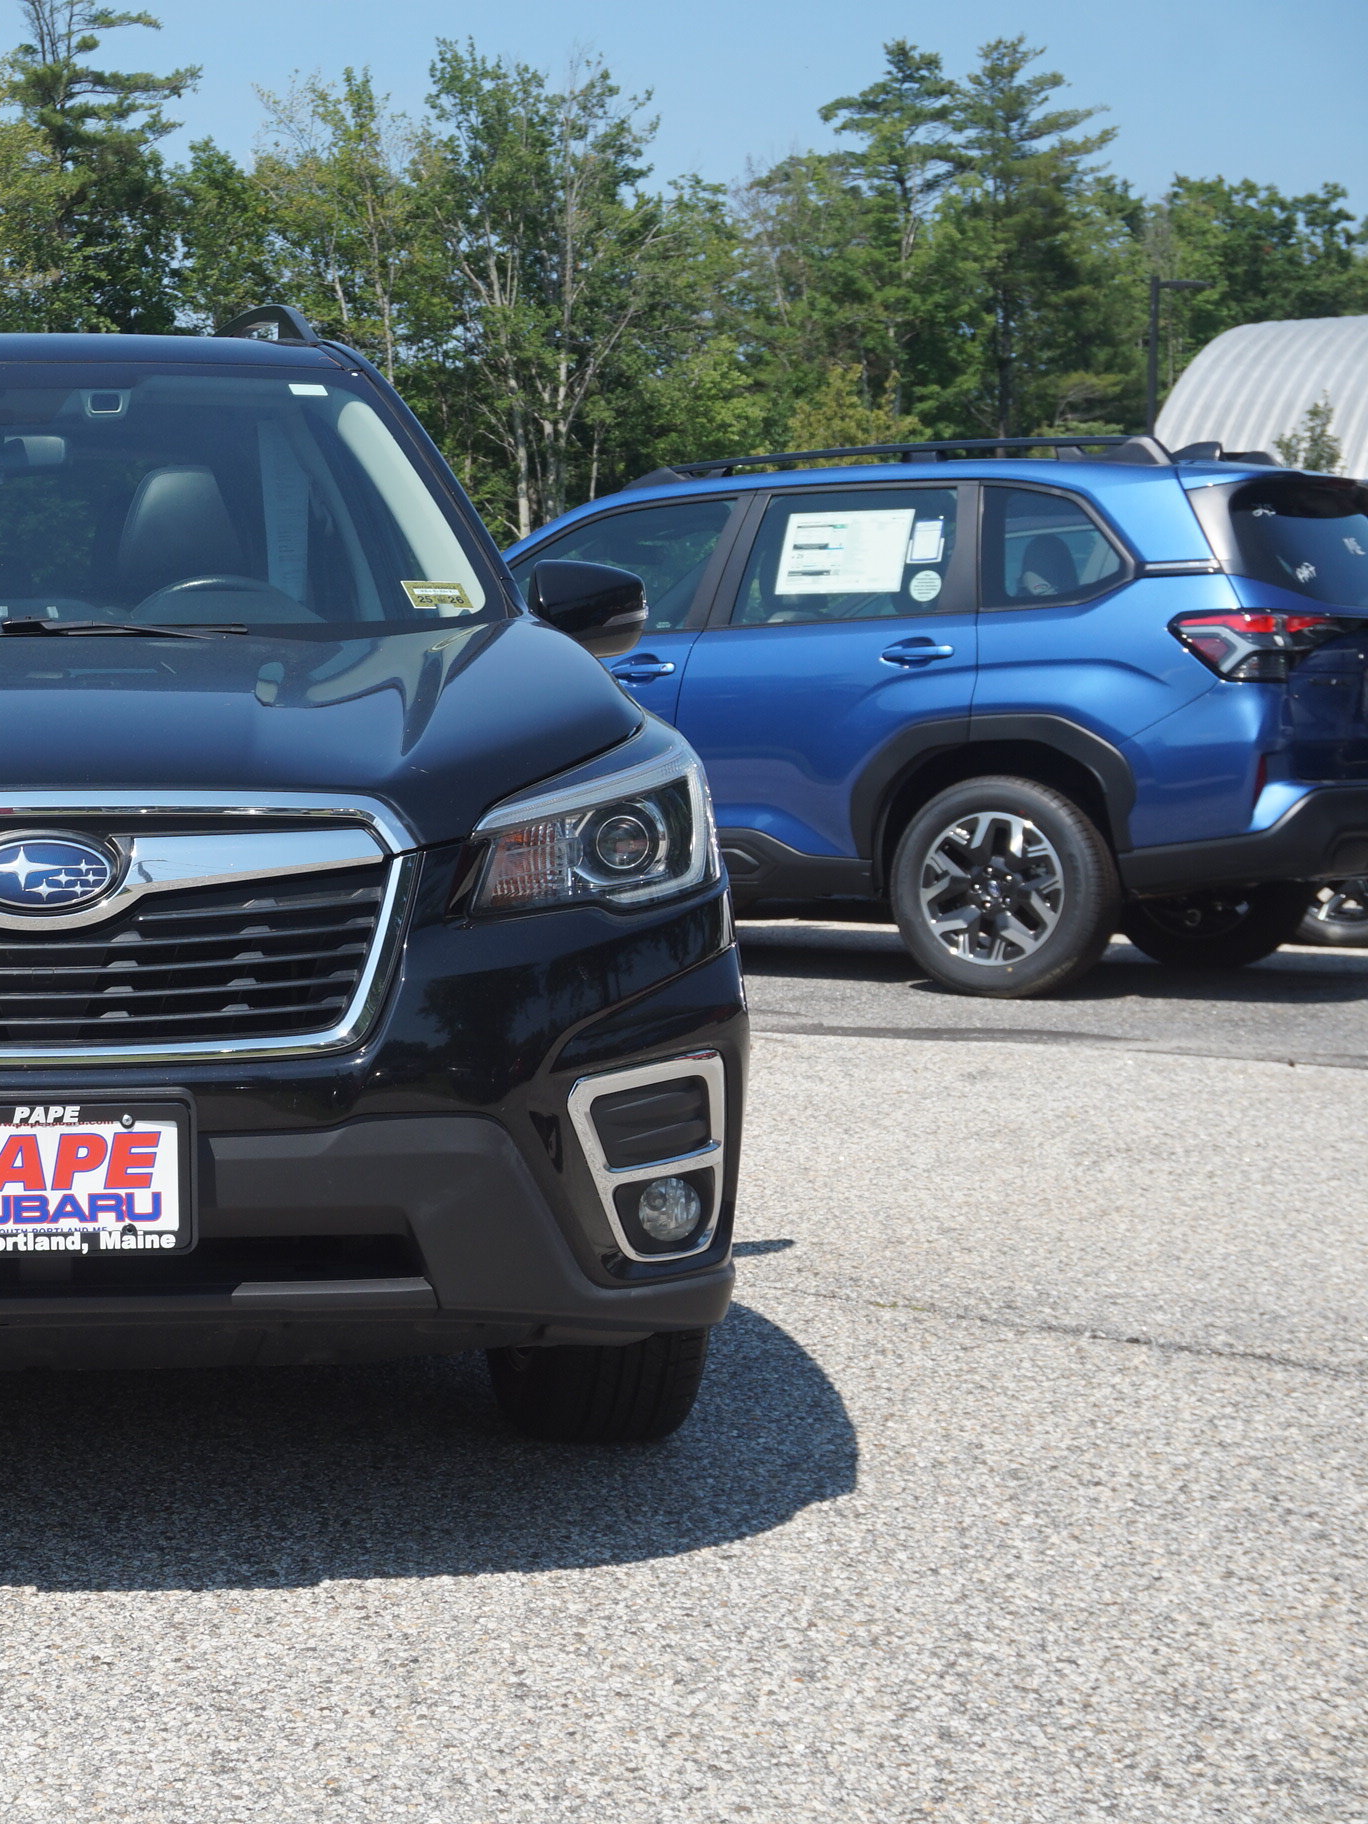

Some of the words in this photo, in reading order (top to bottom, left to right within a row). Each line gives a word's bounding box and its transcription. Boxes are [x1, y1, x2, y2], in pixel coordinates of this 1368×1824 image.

[417, 595, 434, 604] 25
[447, 595, 465, 604] 26
[13, 1106, 80, 1124] PAPE
[99, 1230, 176, 1250] Maine
